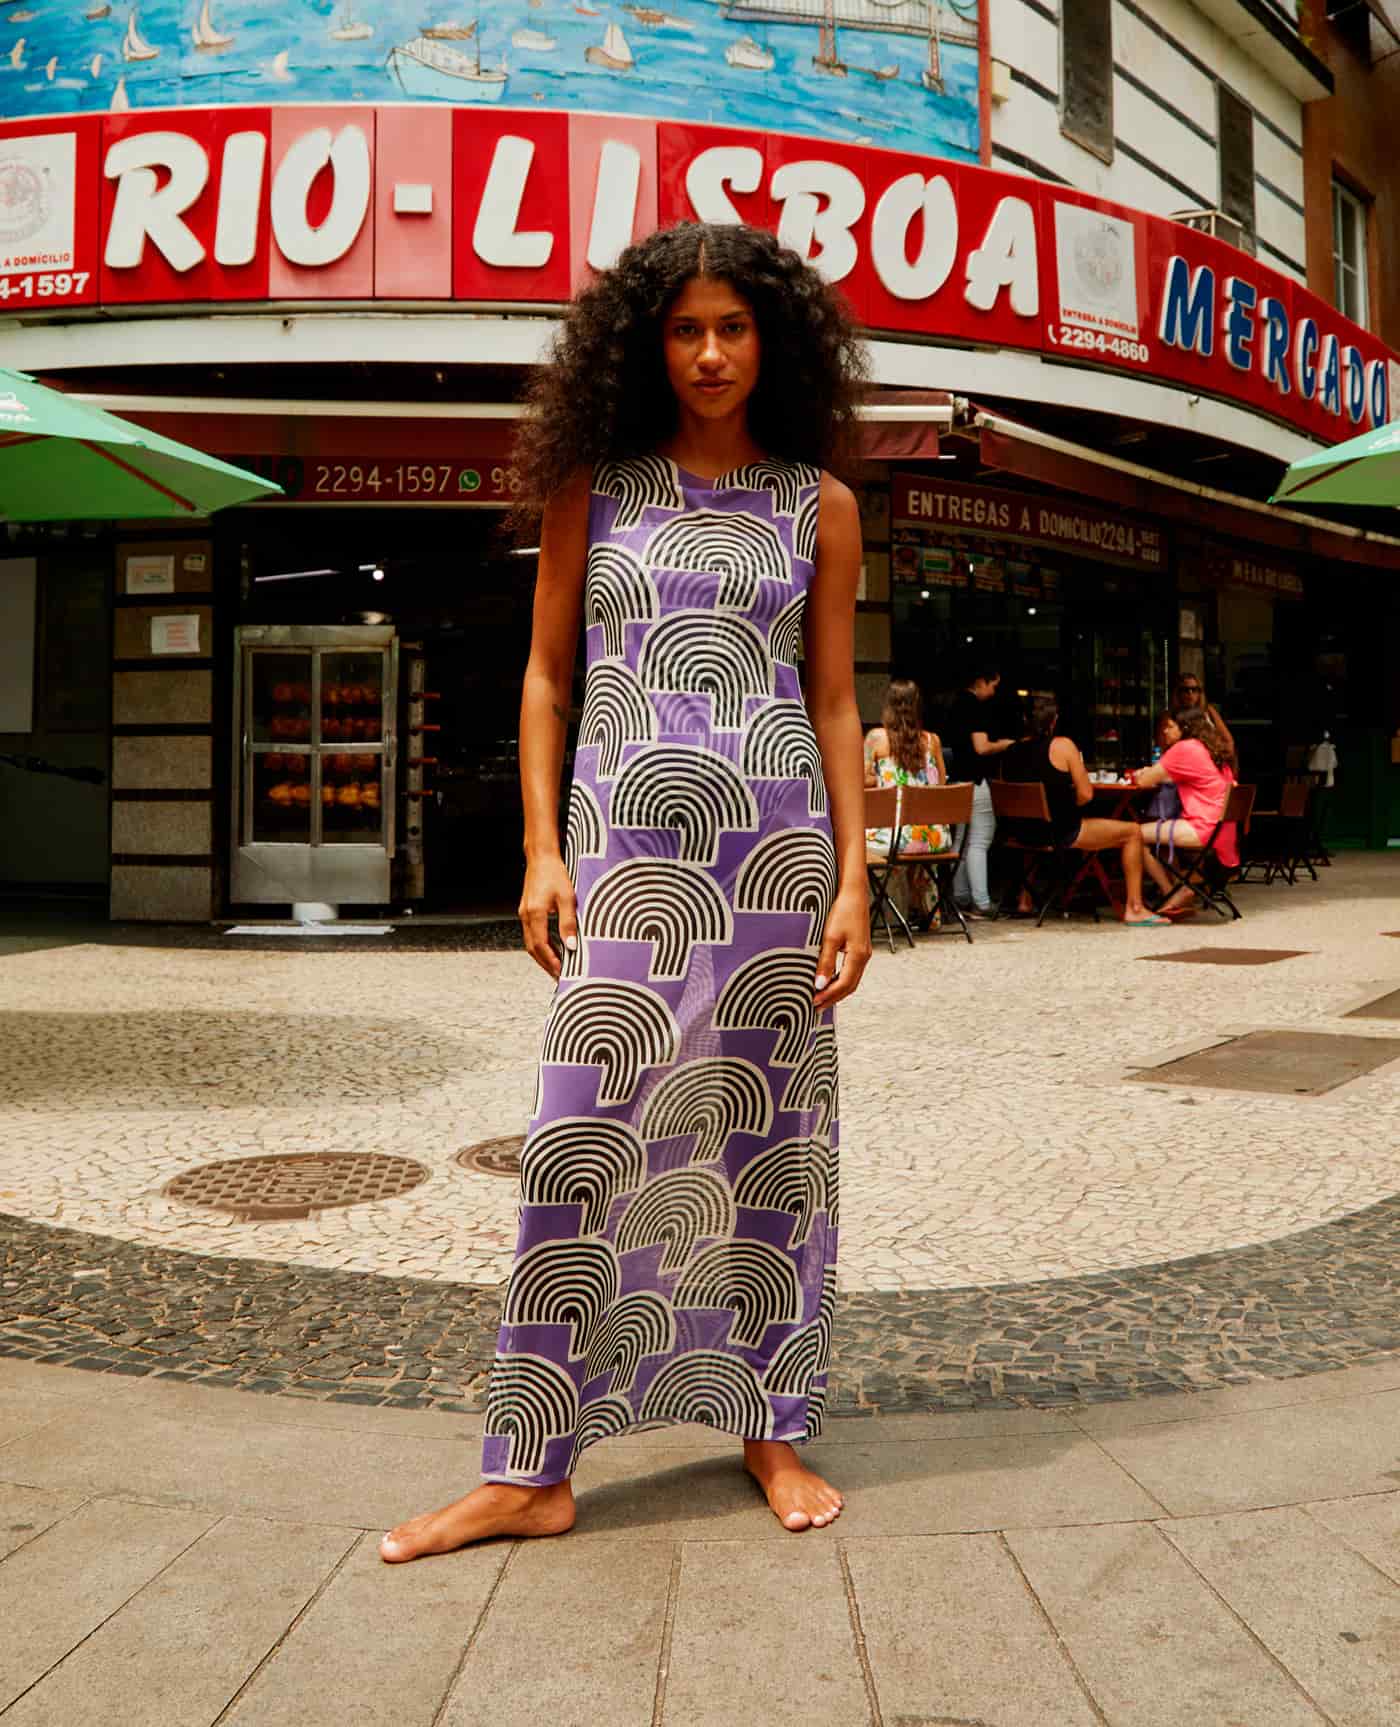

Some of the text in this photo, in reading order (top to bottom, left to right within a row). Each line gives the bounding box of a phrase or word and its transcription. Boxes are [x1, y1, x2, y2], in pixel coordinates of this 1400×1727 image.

[1159, 254, 1388, 430] MERCADO
[314, 465, 453, 494] 2294-1597
[907, 489, 1010, 528] ENTREGAS
[1018, 504, 1030, 532] A
